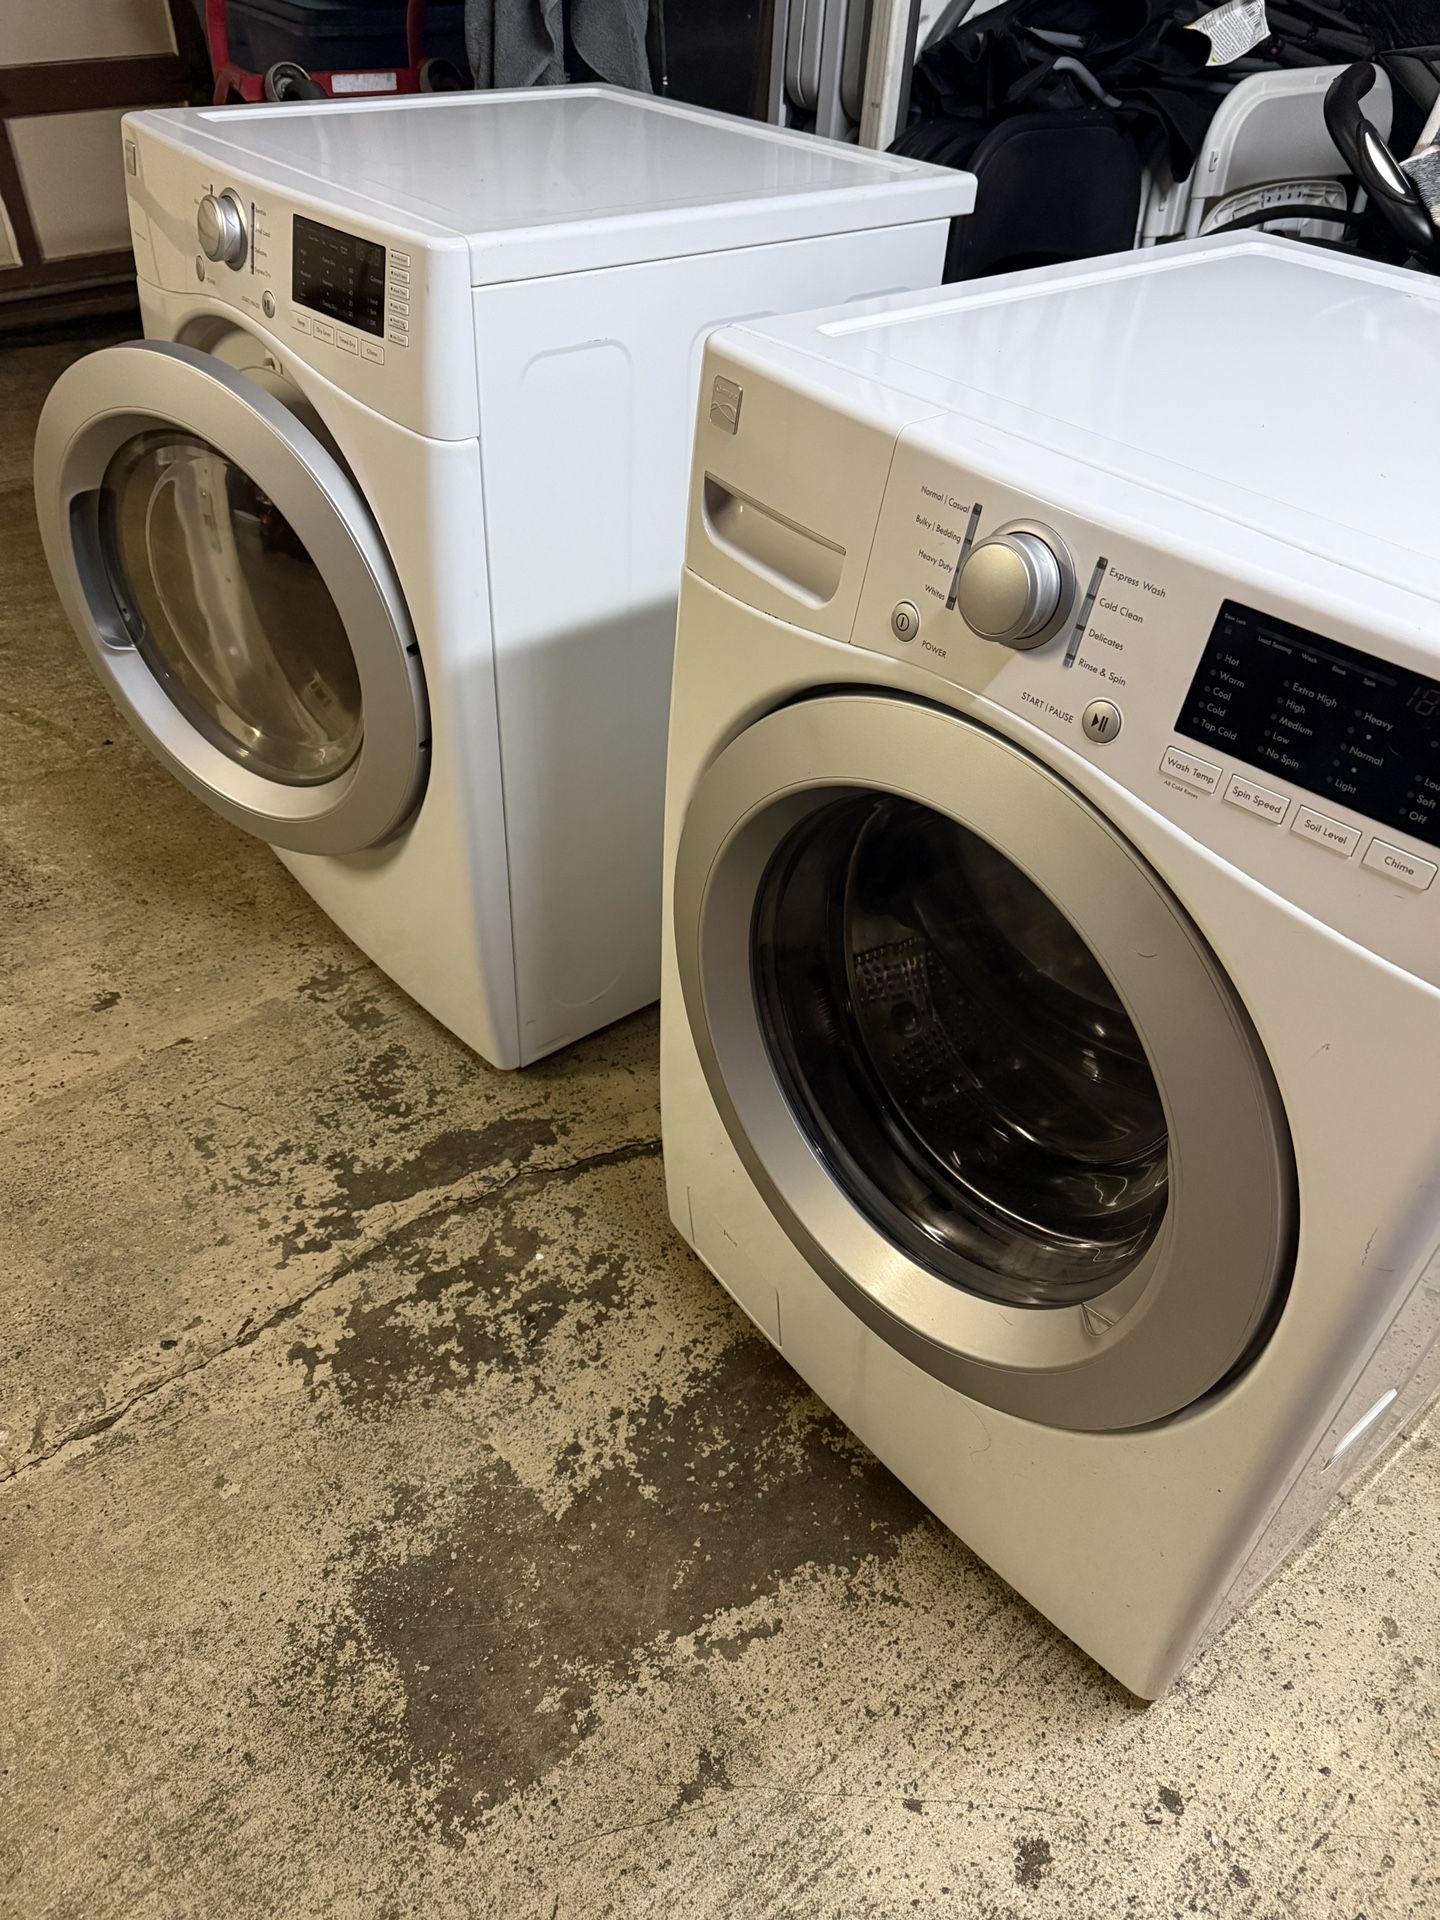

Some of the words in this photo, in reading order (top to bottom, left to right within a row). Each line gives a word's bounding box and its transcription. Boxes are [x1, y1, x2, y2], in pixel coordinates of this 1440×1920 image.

[921, 485, 944, 502] Normal
[948, 497, 970, 514] Casual
[916, 514, 932, 529] Bulky
[936, 524, 962, 544] Bedding
[918, 549, 938, 566] Heavy
[938, 559, 954, 574] Duty
[924, 584, 945, 601] Whites
[1109, 567, 1139, 587] Express
[1142, 580, 1167, 598] Wash
[1099, 597, 1118, 612] Cold
[1119, 606, 1144, 623] Clean
[921, 639, 947, 659] POWER
[1088, 628, 1124, 651] Delicates
[1224, 654, 1240, 667] Hot
[1078, 657, 1098, 674] Rinse
[1099, 668, 1106, 678] &
[1108, 671, 1127, 687] Spin
[1220, 670, 1245, 688] Warm
[1212, 687, 1232, 701] Cool
[1292, 682, 1315, 698] Extra
[1317, 692, 1338, 708] High
[1021, 691, 1044, 709] START
[1048, 705, 1074, 724] PAUSE
[1206, 703, 1226, 717] Cold
[1285, 699, 1306, 714] High
[1278, 716, 1313, 737] Medium
[1364, 712, 1394, 732] Heavy
[1217, 726, 1238, 741] Cold
[1272, 731, 1290, 744] Low
[1266, 747, 1279, 760] No
[1280, 754, 1299, 769] Spin
[1348, 745, 1384, 767] Normal
[1167, 757, 1190, 774] Wash
[1192, 768, 1215, 785] Temp
[1334, 778, 1357, 794] Light
[1424, 777, 1440, 791] Lou
[1232, 785, 1251, 801] Spin
[1253, 795, 1282, 814] Speed
[1416, 794, 1437, 809] Soft
[1409, 811, 1428, 825] Off
[1304, 819, 1322, 833] Soil
[1323, 827, 1348, 845] Level
[1384, 856, 1415, 876] Chime
